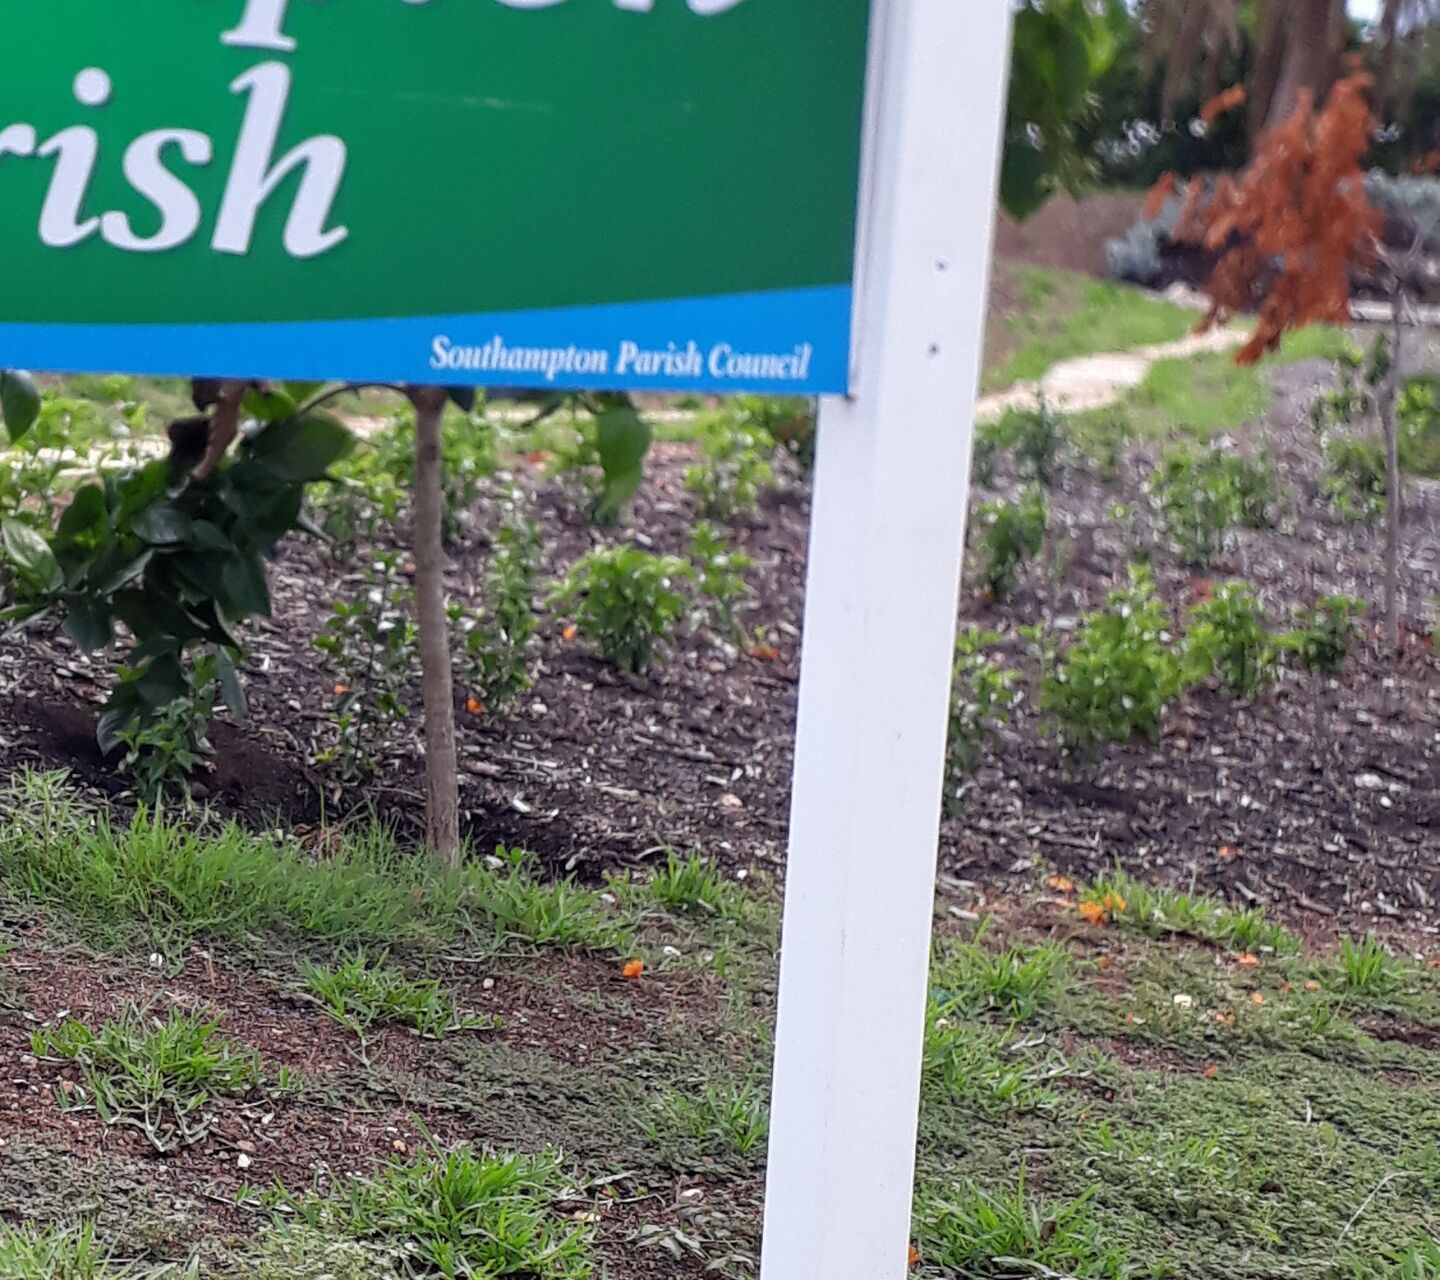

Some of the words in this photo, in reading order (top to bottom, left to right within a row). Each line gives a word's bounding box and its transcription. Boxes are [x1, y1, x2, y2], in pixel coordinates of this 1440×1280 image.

[430, 336, 607, 380] Southampton
[615, 340, 702, 376] Parish
[708, 342, 810, 378] Council
